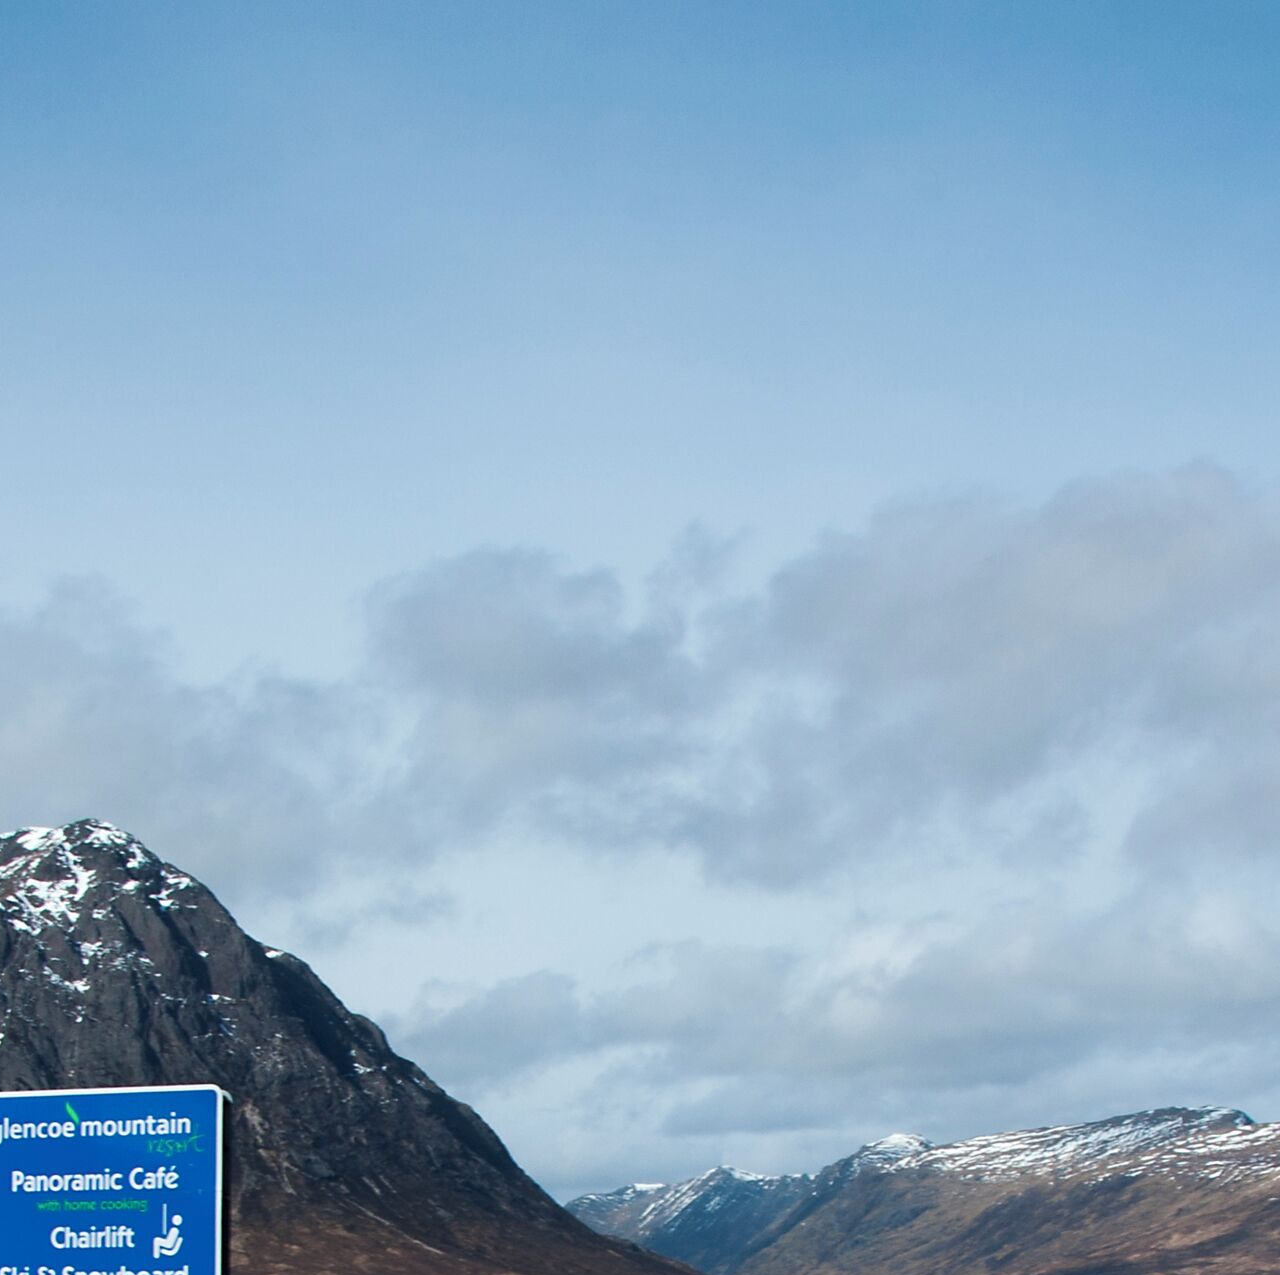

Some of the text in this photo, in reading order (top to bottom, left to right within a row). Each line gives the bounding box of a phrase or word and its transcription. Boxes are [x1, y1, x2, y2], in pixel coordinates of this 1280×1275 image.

[80, 1112, 191, 1137] mountain
[11, 1165, 179, 1193] Panoramic Café
[64, 1199, 97, 1211] home
[100, 1197, 148, 1213] cooking
[50, 1225, 135, 1249] Chairlift
